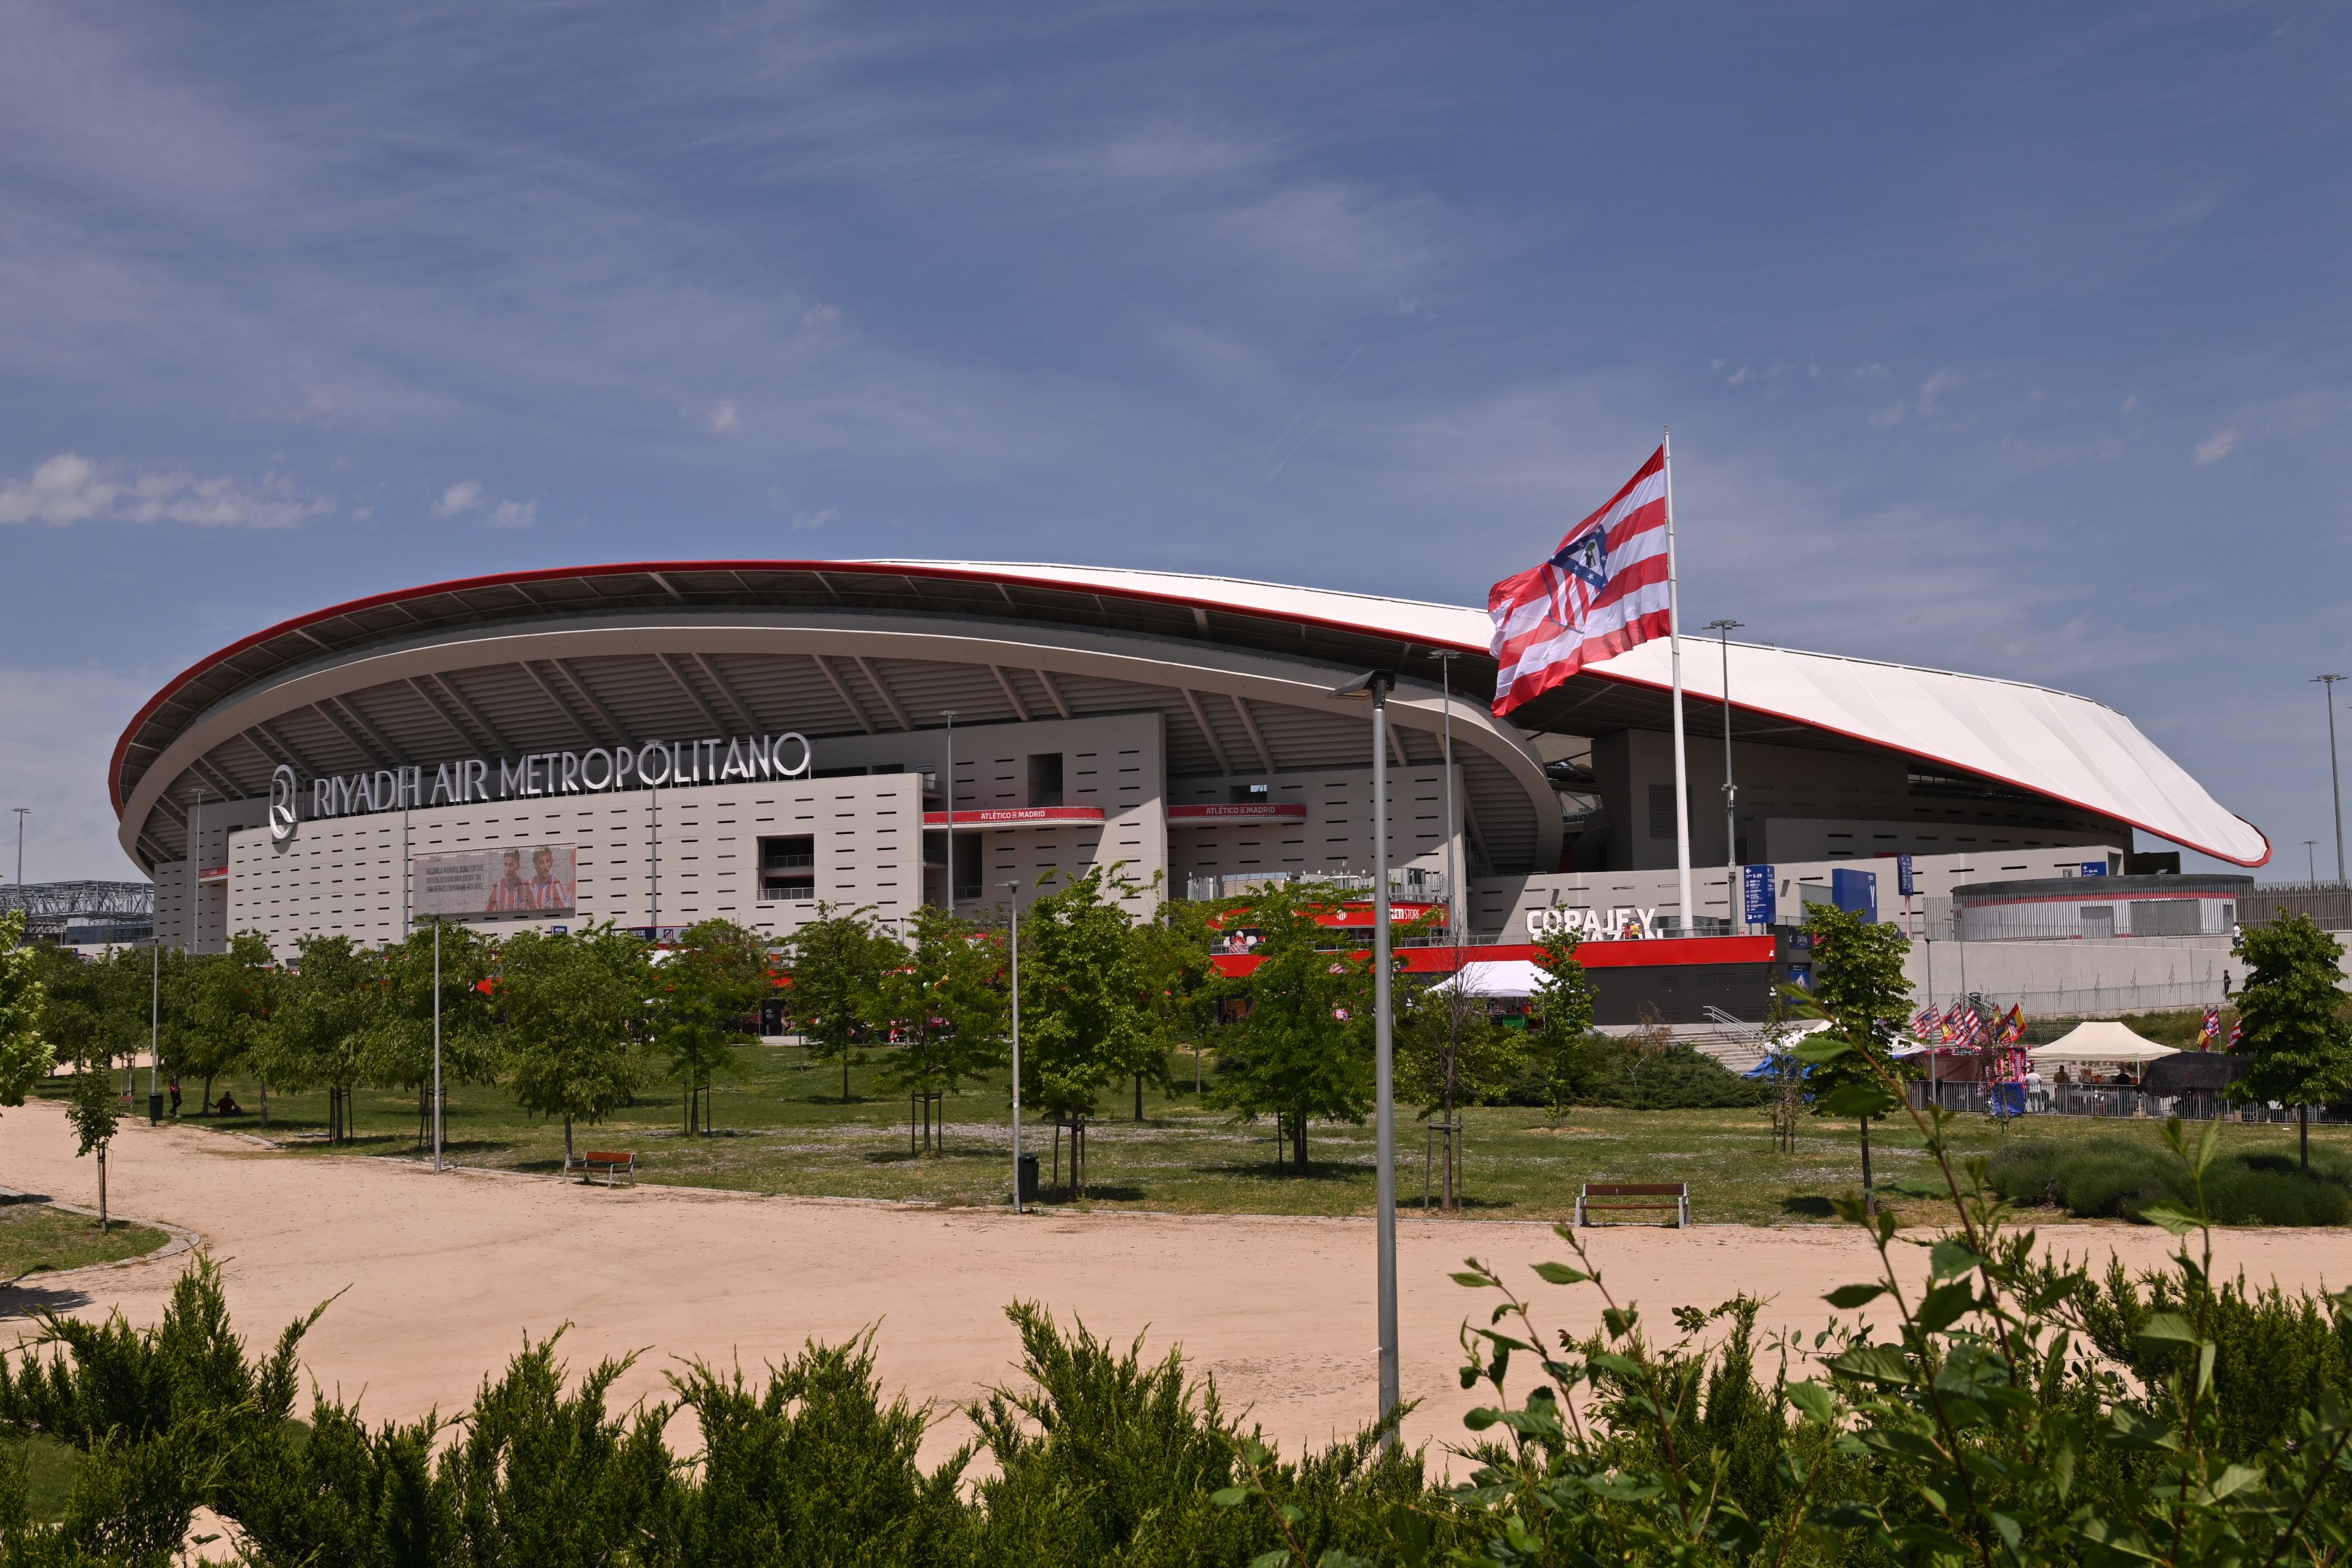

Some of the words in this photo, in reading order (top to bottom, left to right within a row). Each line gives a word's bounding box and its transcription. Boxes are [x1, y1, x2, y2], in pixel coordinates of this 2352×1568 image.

[314, 766, 422, 817] RIYADH
[430, 759, 489, 804] AIR
[501, 732, 812, 797] METROPOLITANO
[1206, 806, 1238, 814] ATLÉTICO
[981, 811, 1011, 820] ATLÉTICO
[1404, 908, 1421, 920] STORE
